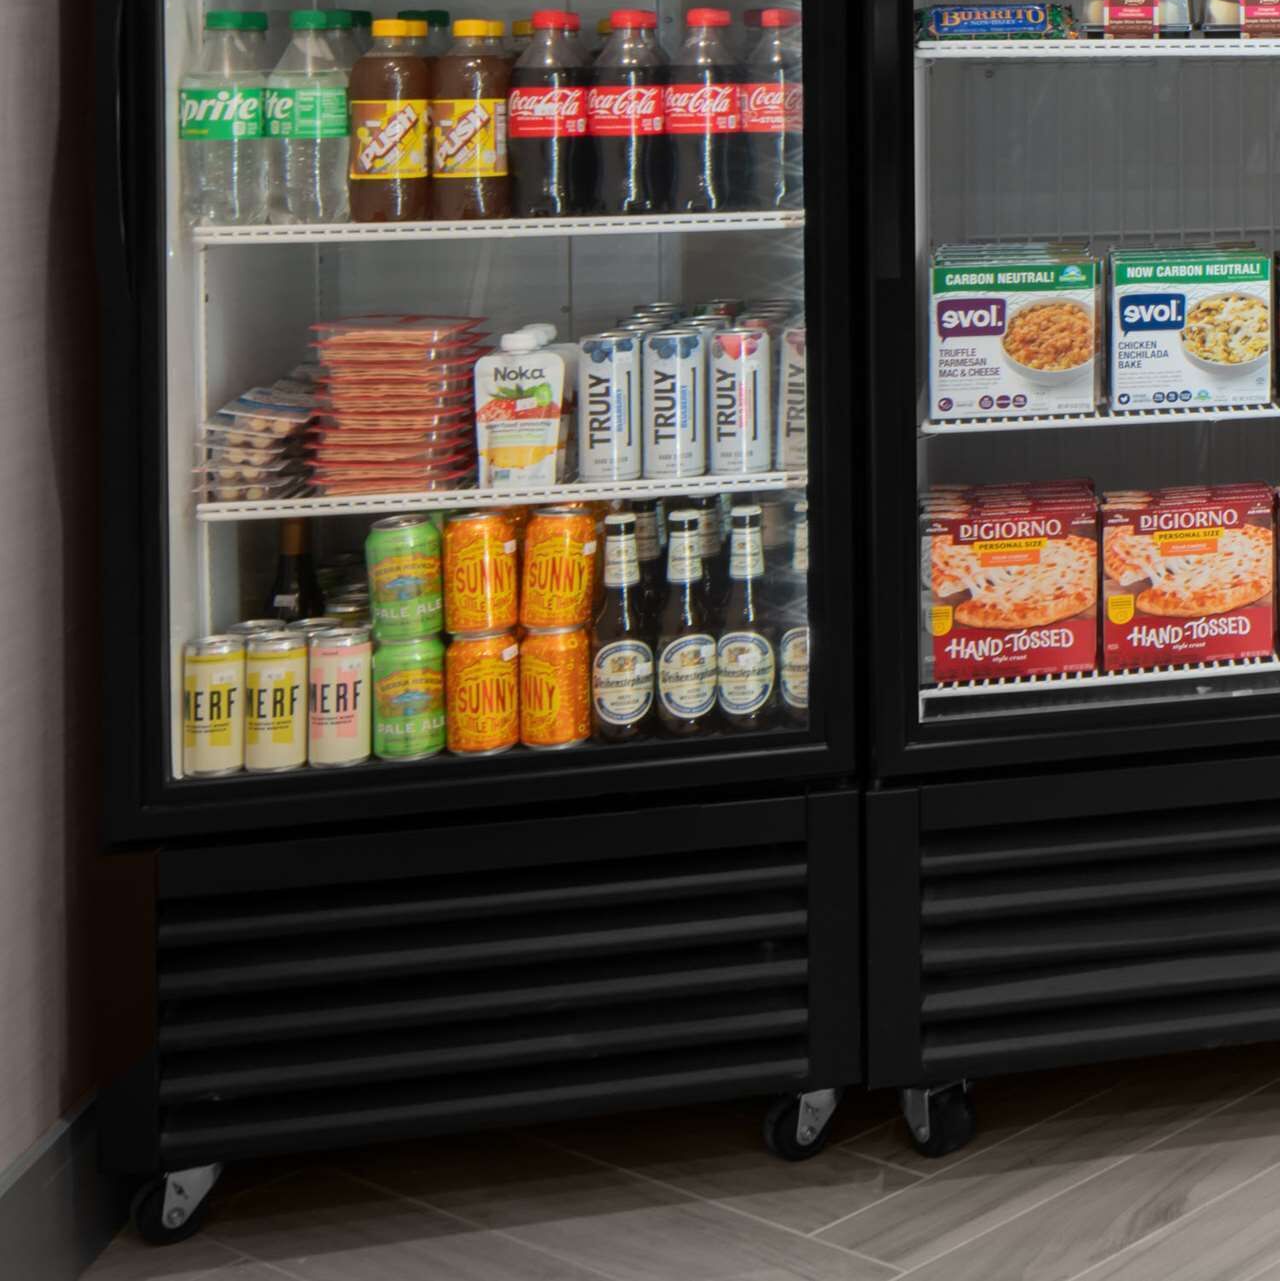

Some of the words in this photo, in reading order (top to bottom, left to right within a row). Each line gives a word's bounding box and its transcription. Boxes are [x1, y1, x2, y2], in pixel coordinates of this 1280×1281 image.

[941, 7, 1046, 26] BURRITO
[182, 91, 258, 121] prite
[510, 89, 583, 117] Coca-Cola
[588, 87, 658, 116] Coca-Cola
[665, 86, 731, 114] Coca-Cola
[945, 272, 994, 286] CARBON
[997, 271, 1055, 284] NEUTRAL!
[1126, 266, 1154, 279] NOW
[1156, 265, 1203, 277] CARBON
[1206, 263, 1261, 275] NEUTRAL!
[941, 304, 1003, 329] evol.
[1123, 299, 1183, 323] evol.
[939, 348, 976, 357] TRUFFLE
[1118, 341, 1158, 350] CHICKEN
[1118, 350, 1169, 359] ENCHILADA
[494, 366, 545, 382] Noka
[938, 358, 987, 367] PARMESAN
[938, 368, 958, 377] MAC
[960, 368, 967, 377] &
[968, 367, 1000, 376] CHEESE
[1118, 360, 1142, 369] BAKE
[588, 373, 611, 450] TRULY
[654, 369, 677, 445] TRULY
[716, 368, 737, 442] TRULY
[785, 363, 806, 438] TRULY
[978, 541, 1023, 550] PERSONAL
[1158, 531, 1201, 541] PERSONAL
[1203, 530, 1220, 538] SIZE
[455, 558, 514, 594] SUNNY
[528, 558, 586, 592] SUNNY
[416, 599, 441, 616] ALE
[1127, 615, 1251, 648] HAND-TOSSED
[944, 628, 1075, 661] HAND-TOSSED
[458, 678, 515, 713] SUNNY
[522, 676, 556, 711] NNY
